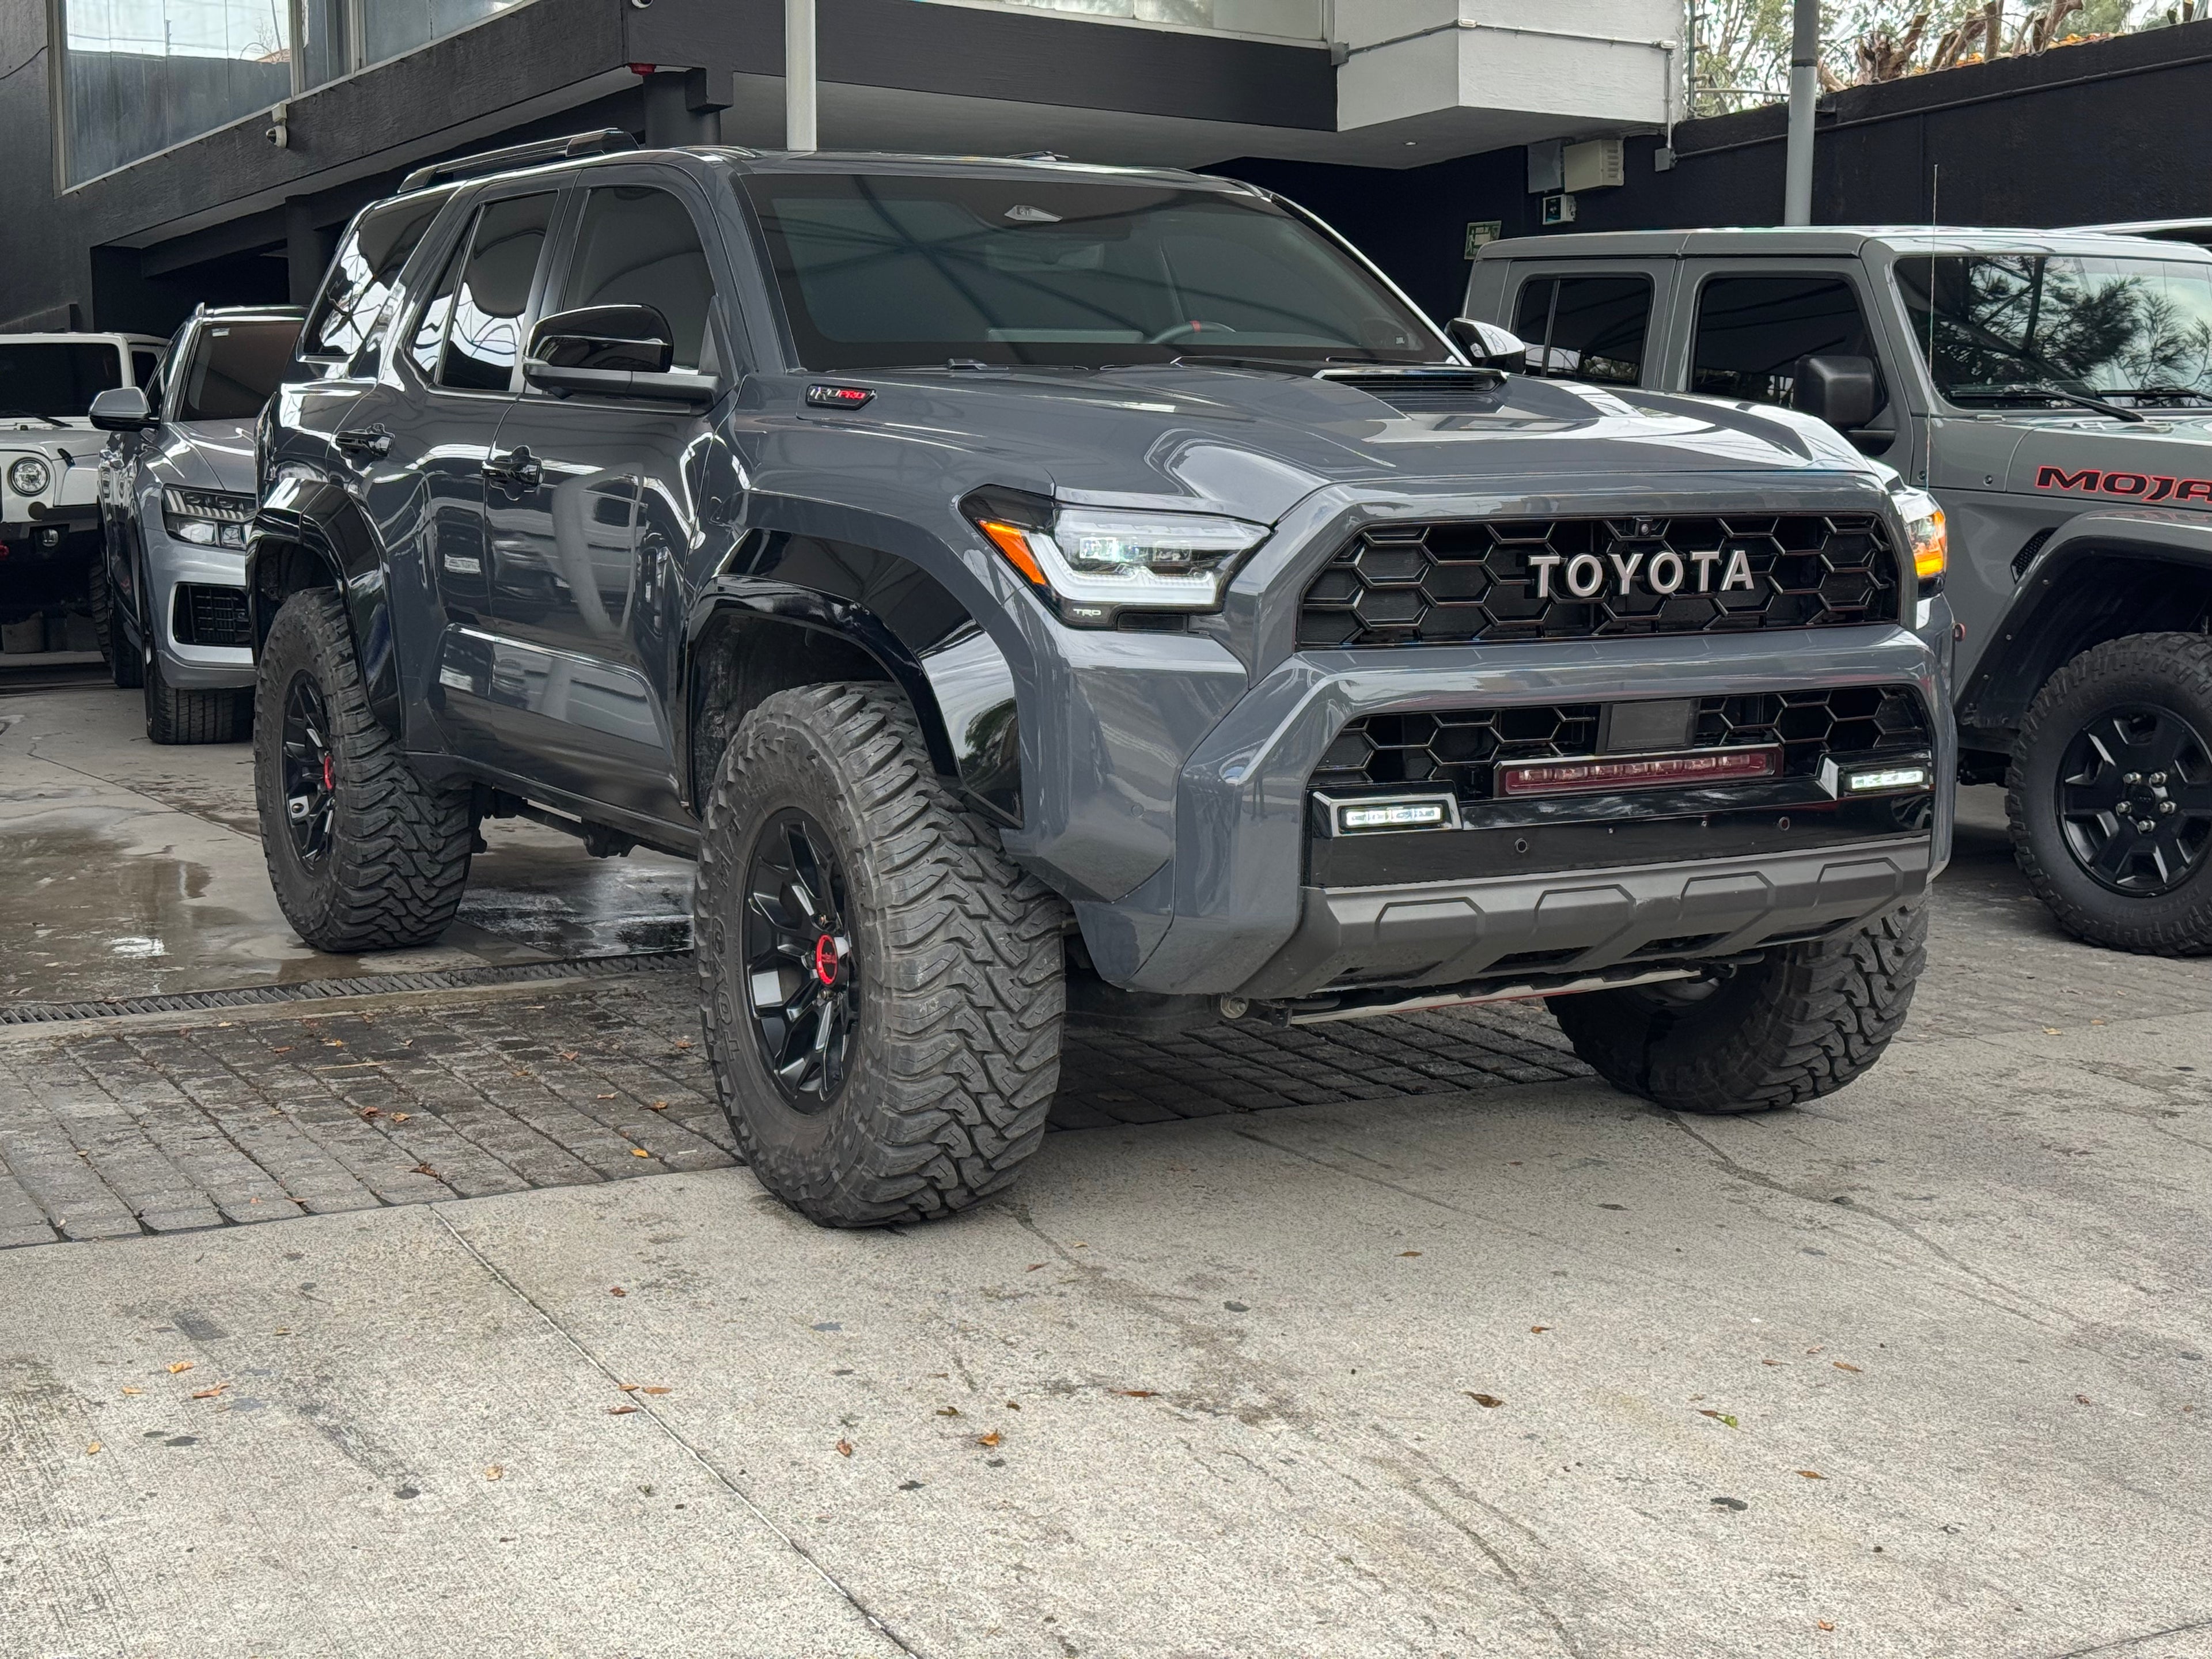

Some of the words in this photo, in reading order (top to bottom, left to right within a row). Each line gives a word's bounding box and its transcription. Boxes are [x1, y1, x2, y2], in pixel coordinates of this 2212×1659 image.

[839, 389, 866, 400] PRO
[2035, 465, 2212, 503] MOJA
[1528, 550, 1755, 598] TOYOTA
[1073, 608, 1101, 616] TRD
[711, 916, 740, 1062] TOYO
